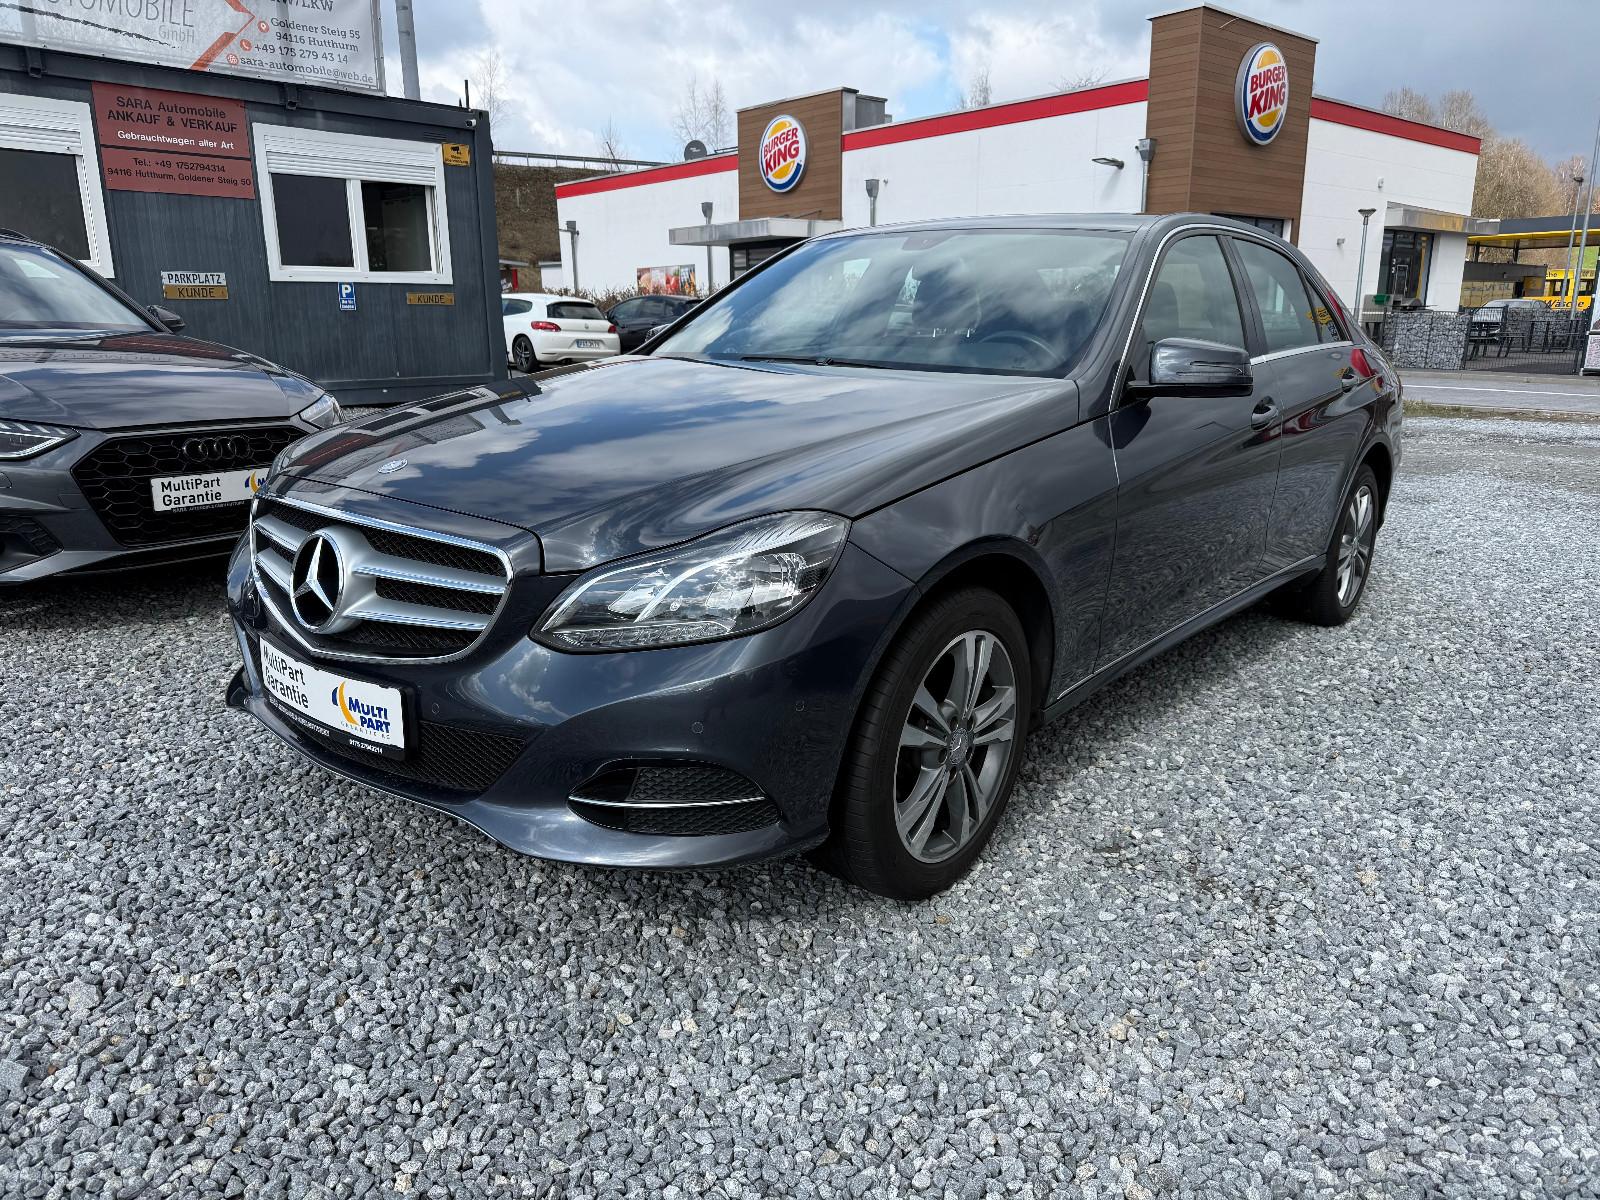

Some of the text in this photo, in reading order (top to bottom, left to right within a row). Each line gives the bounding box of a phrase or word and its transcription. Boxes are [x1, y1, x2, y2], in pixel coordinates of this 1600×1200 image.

[158, 24, 195, 42] GmbH
[270, 18, 360, 39] Goldener Steig 55
[276, 32, 358, 52] 94116 Hutthurm
[254, 44, 348, 64] +49 175 279 43 14
[240, 57, 373, 83] sara-automobile@web.de
[1250, 66, 1285, 93] BURGER
[117, 96, 226, 119] SARA Automobile
[1249, 82, 1286, 119] KING
[108, 110, 237, 133] ANKAUF & VERKAUF
[118, 130, 234, 150] Gebrauchtwagen aller Art
[764, 127, 798, 159] BURGER
[133, 158, 225, 173] Tel.: +49 1752794314
[764, 140, 799, 176] KING
[108, 168, 251, 186] 94116 Hutthurm, Goldener Steig 50
[168, 274, 222, 284] PARKPLATZ
[178, 288, 215, 298] KUNDE
[341, 284, 352, 298] P
[417, 295, 445, 303] KUNDE
[161, 477, 220, 492] MultiPart
[163, 490, 222, 506] Garantie
[348, 697, 388, 720] MULTI
[360, 716, 390, 733] PART
